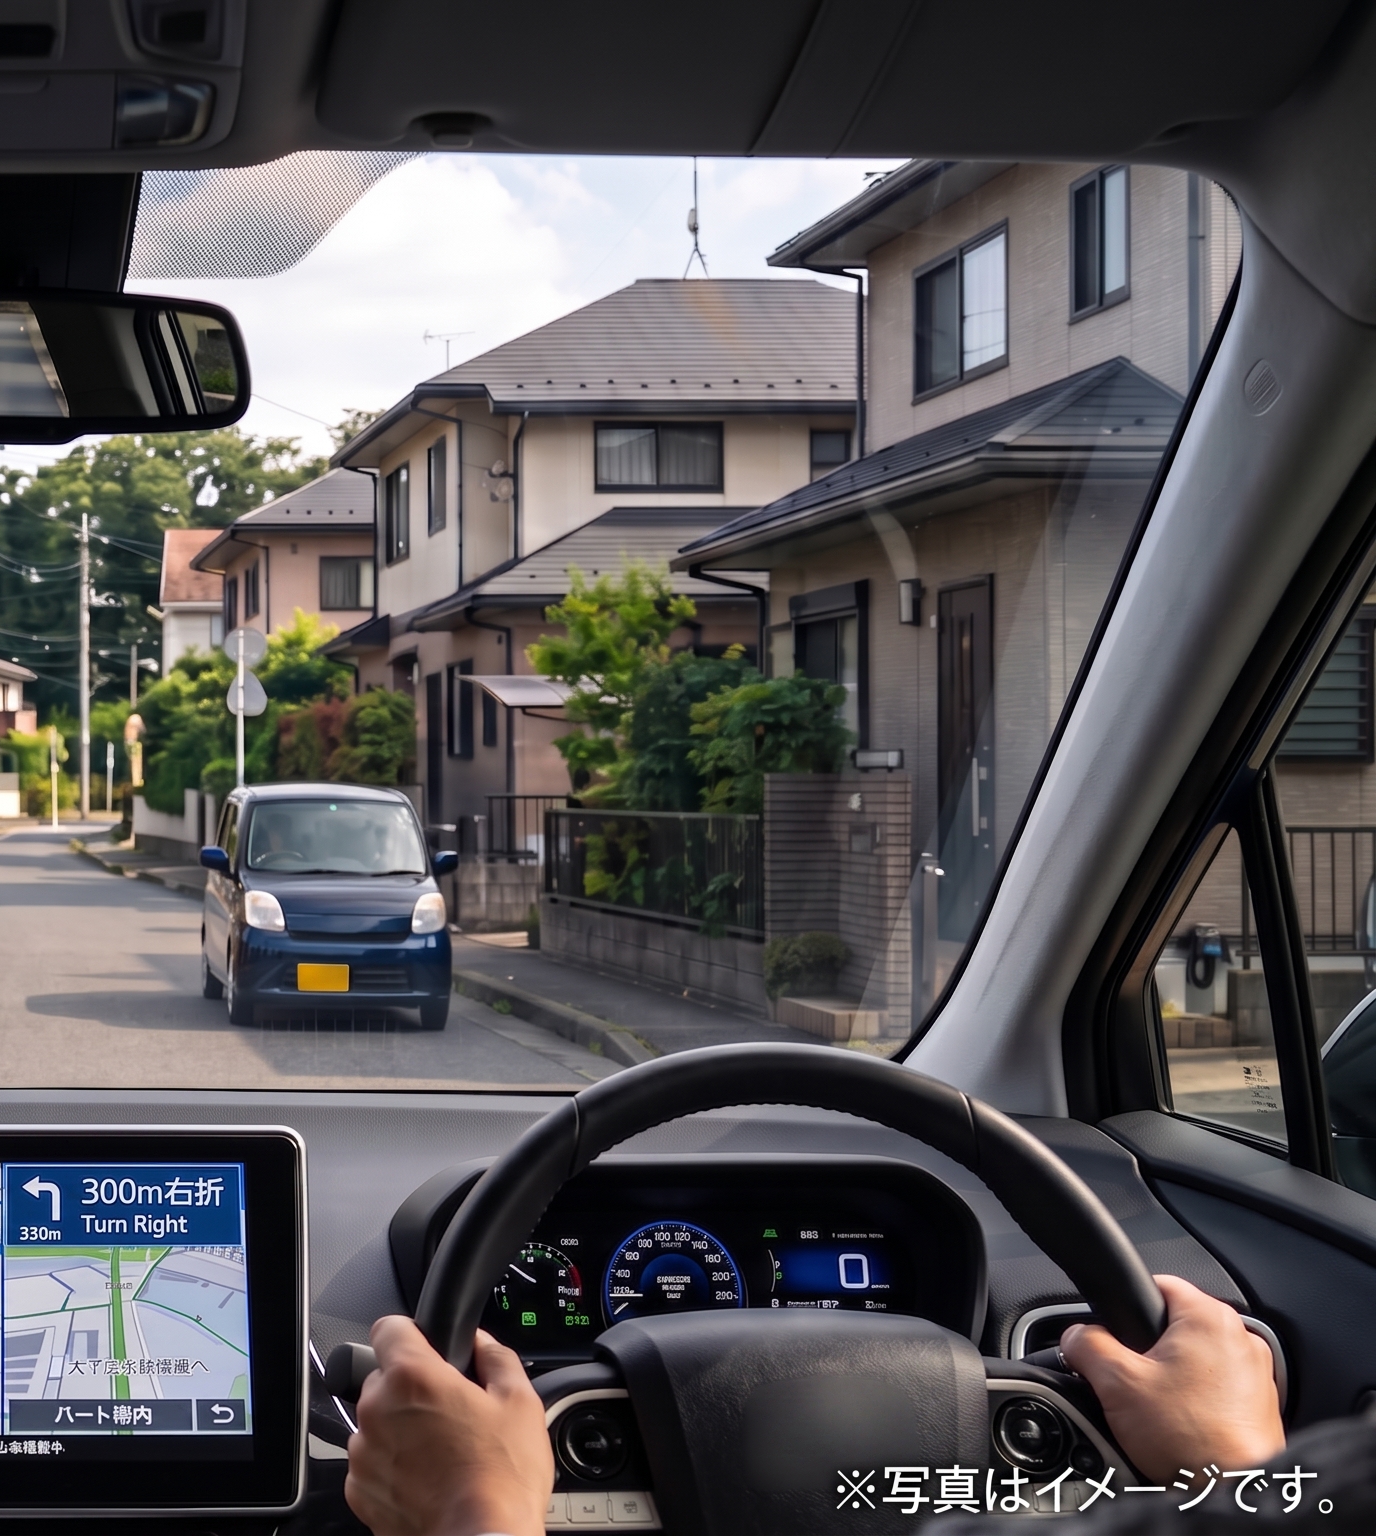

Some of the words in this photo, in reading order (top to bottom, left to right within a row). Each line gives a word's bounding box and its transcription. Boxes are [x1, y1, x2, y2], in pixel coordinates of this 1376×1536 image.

[80, 1177, 224, 1207] 300m右折
[19, 1227, 62, 1241] 330m
[80, 1214, 127, 1233] Turn
[134, 1214, 188, 1238] Right
